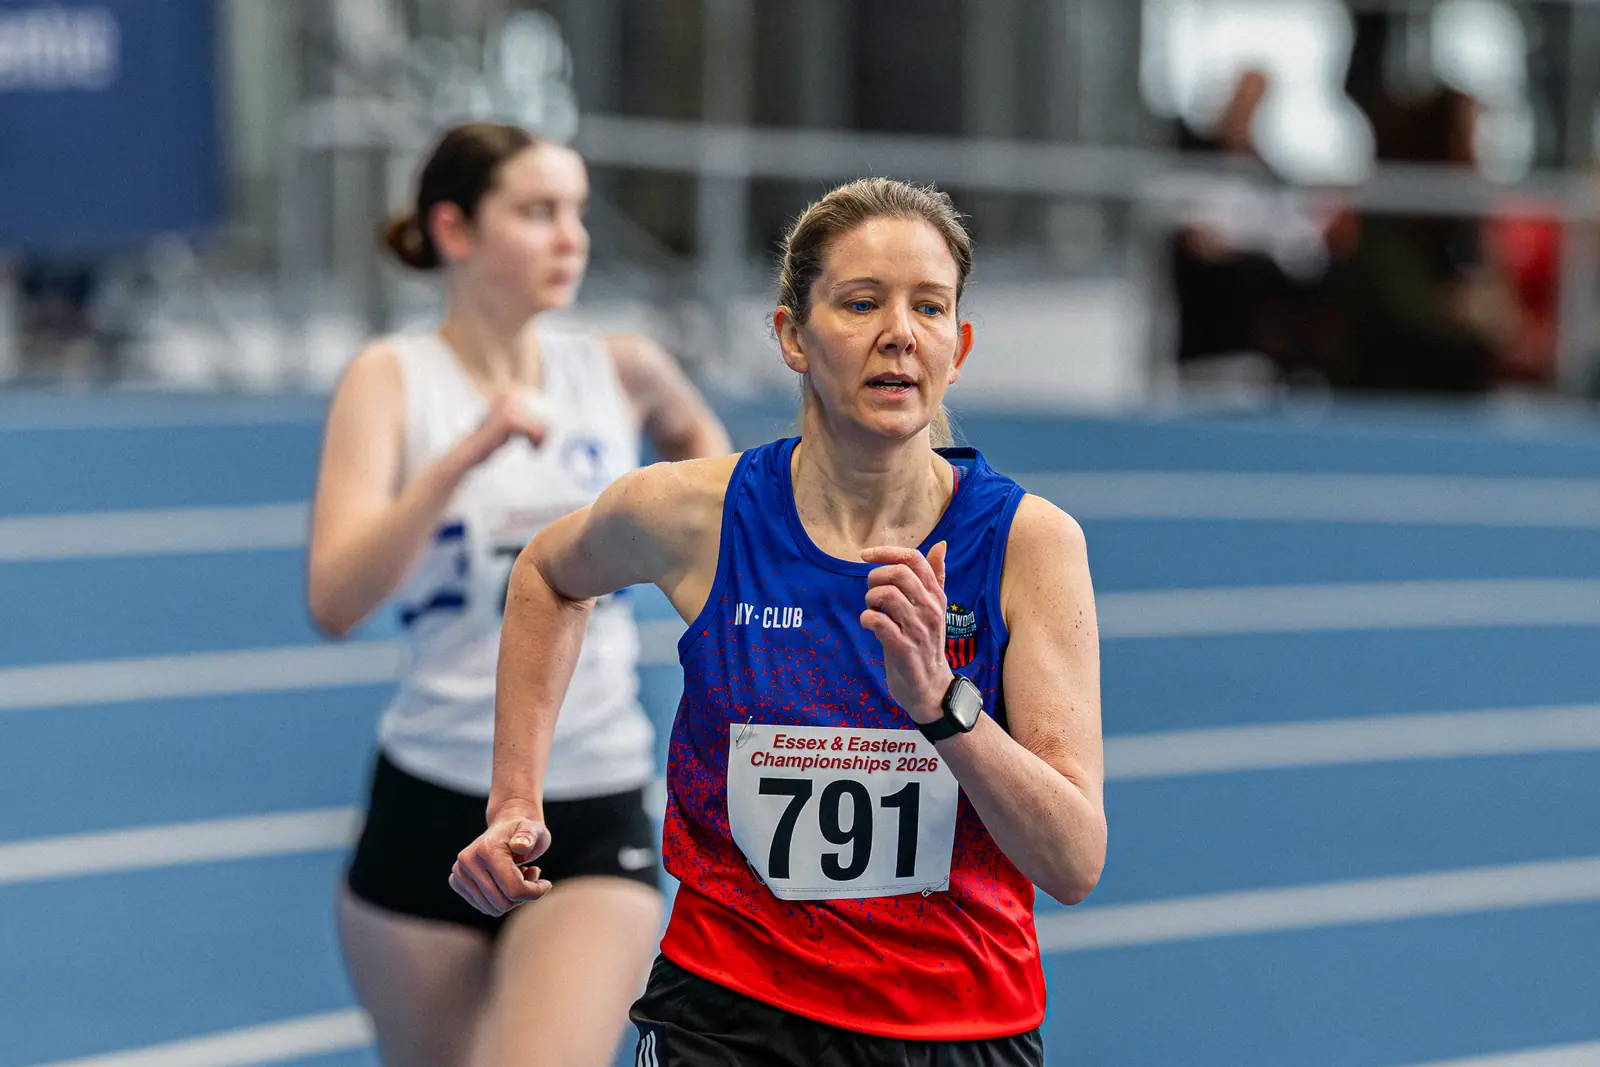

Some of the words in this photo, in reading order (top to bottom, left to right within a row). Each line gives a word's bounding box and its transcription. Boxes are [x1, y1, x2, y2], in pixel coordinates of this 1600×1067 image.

[773, 733, 828, 750] Essex
[830, 736, 844, 751] &
[847, 736, 917, 754] Eastern
[750, 751, 892, 775] Championships
[895, 757, 939, 773] 2026
[758, 777, 921, 882] 791
